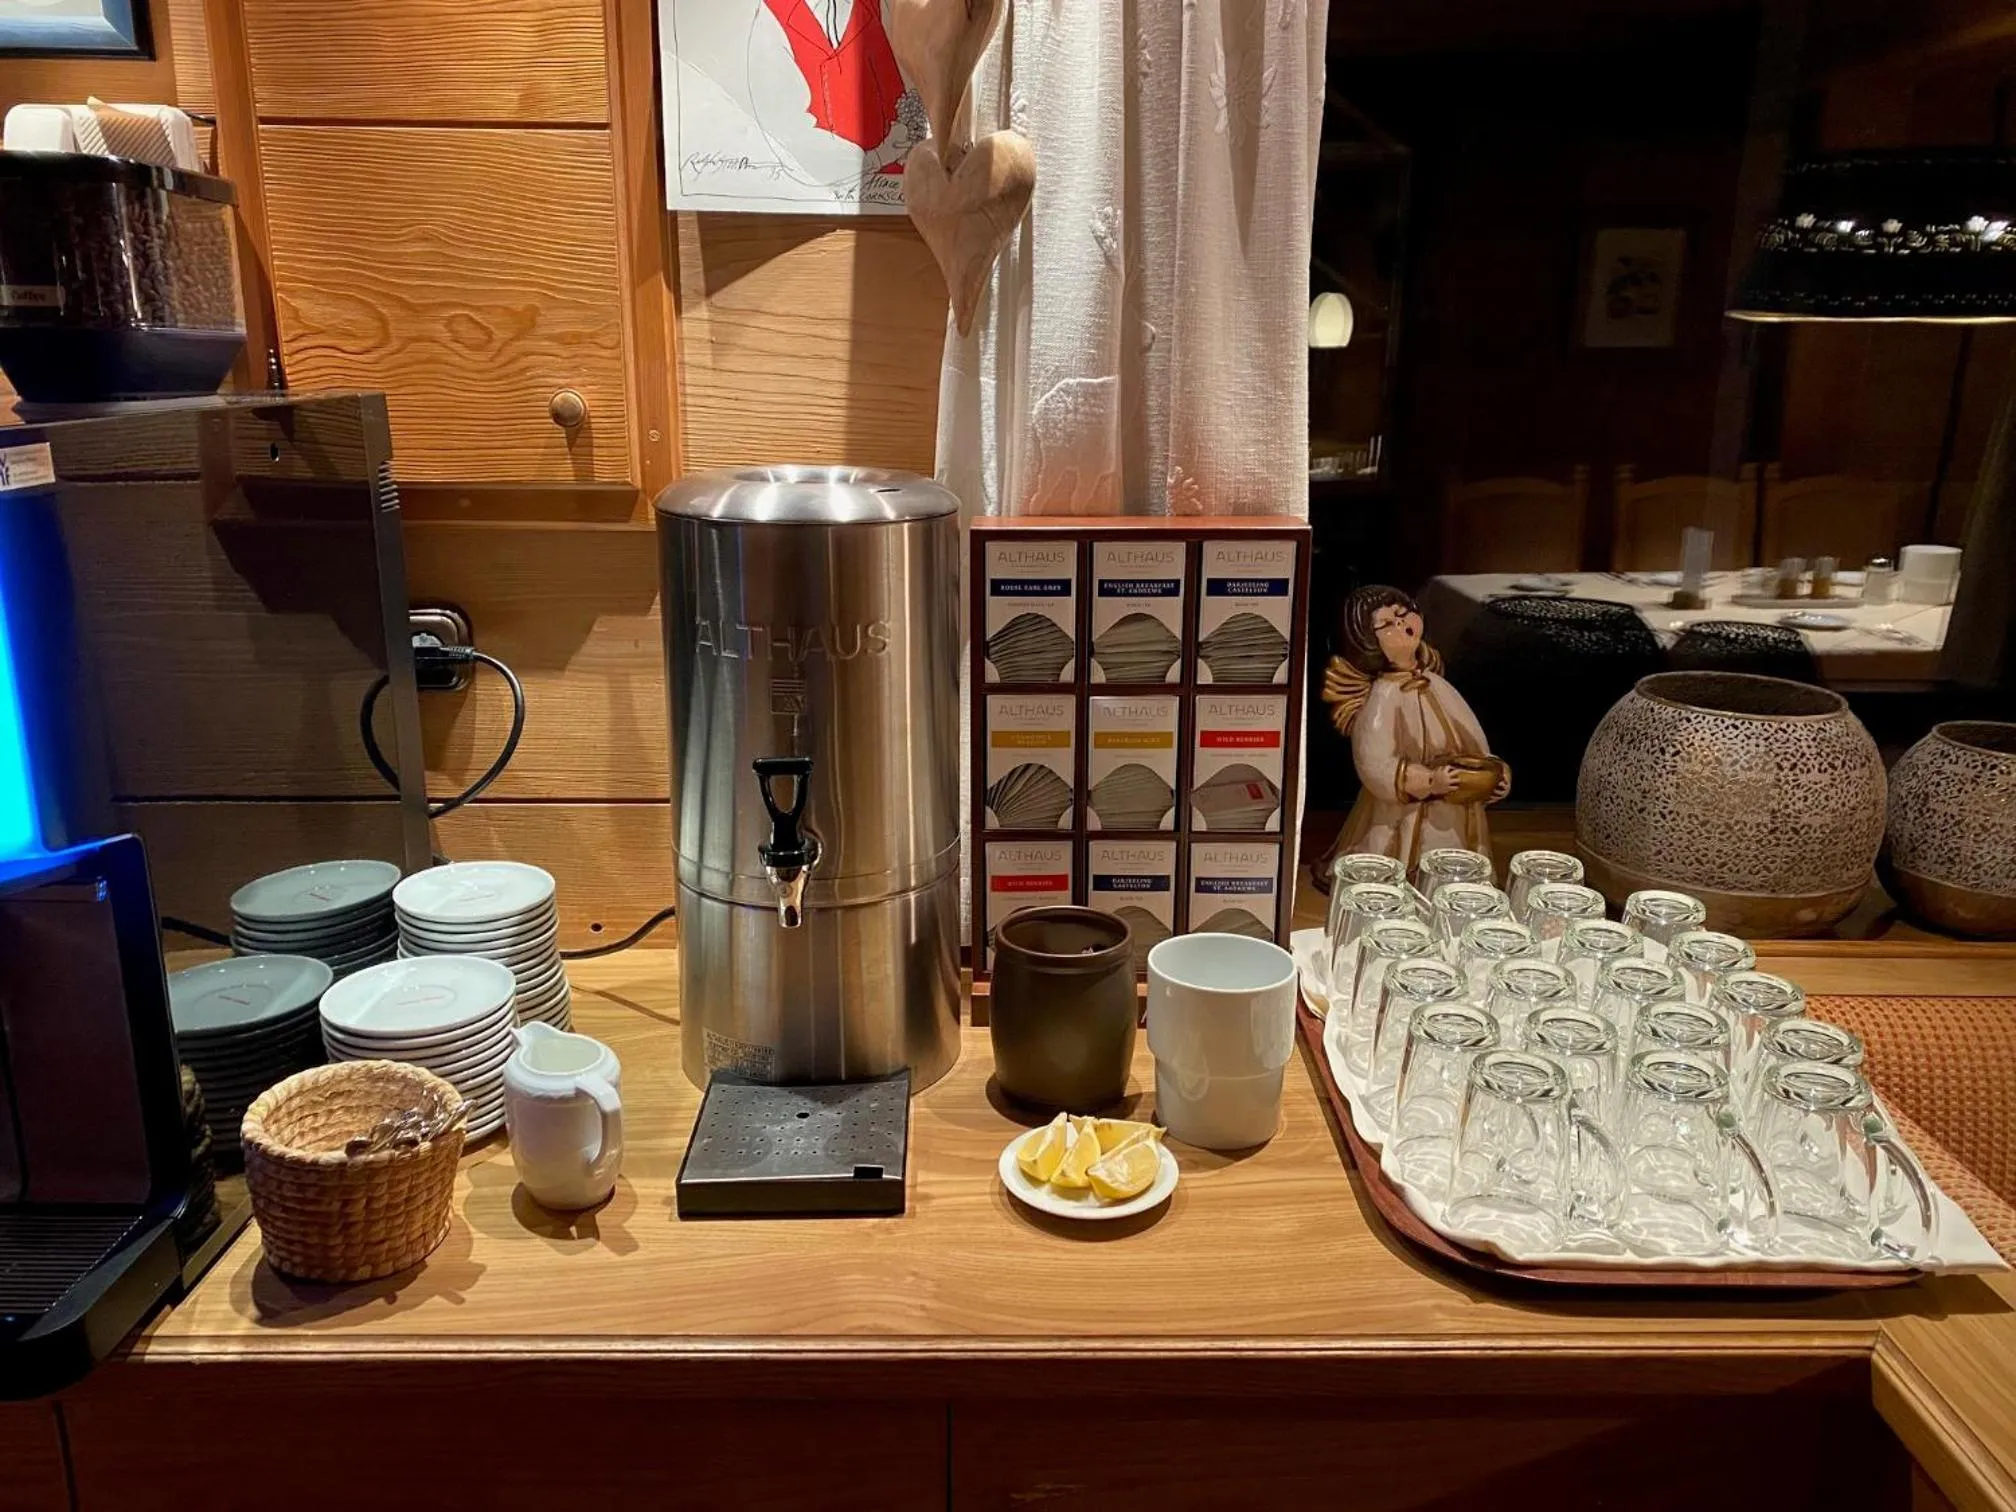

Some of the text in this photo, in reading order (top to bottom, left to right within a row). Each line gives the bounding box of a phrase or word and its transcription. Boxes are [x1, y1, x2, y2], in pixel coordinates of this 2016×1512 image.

[998, 551, 1065, 563] ALTHAUS
[1106, 551, 1176, 564] ALTHAUS
[1215, 550, 1286, 563] ALTHAUS
[694, 620, 892, 661] ALTHAUS
[998, 704, 1065, 717] ALTHAUS
[1208, 704, 1276, 716] ALTHAUS
[998, 849, 1062, 861] ALTHAUS
[1101, 849, 1165, 861] ALTHAUS
[1203, 852, 1269, 864] ALTHAUS
